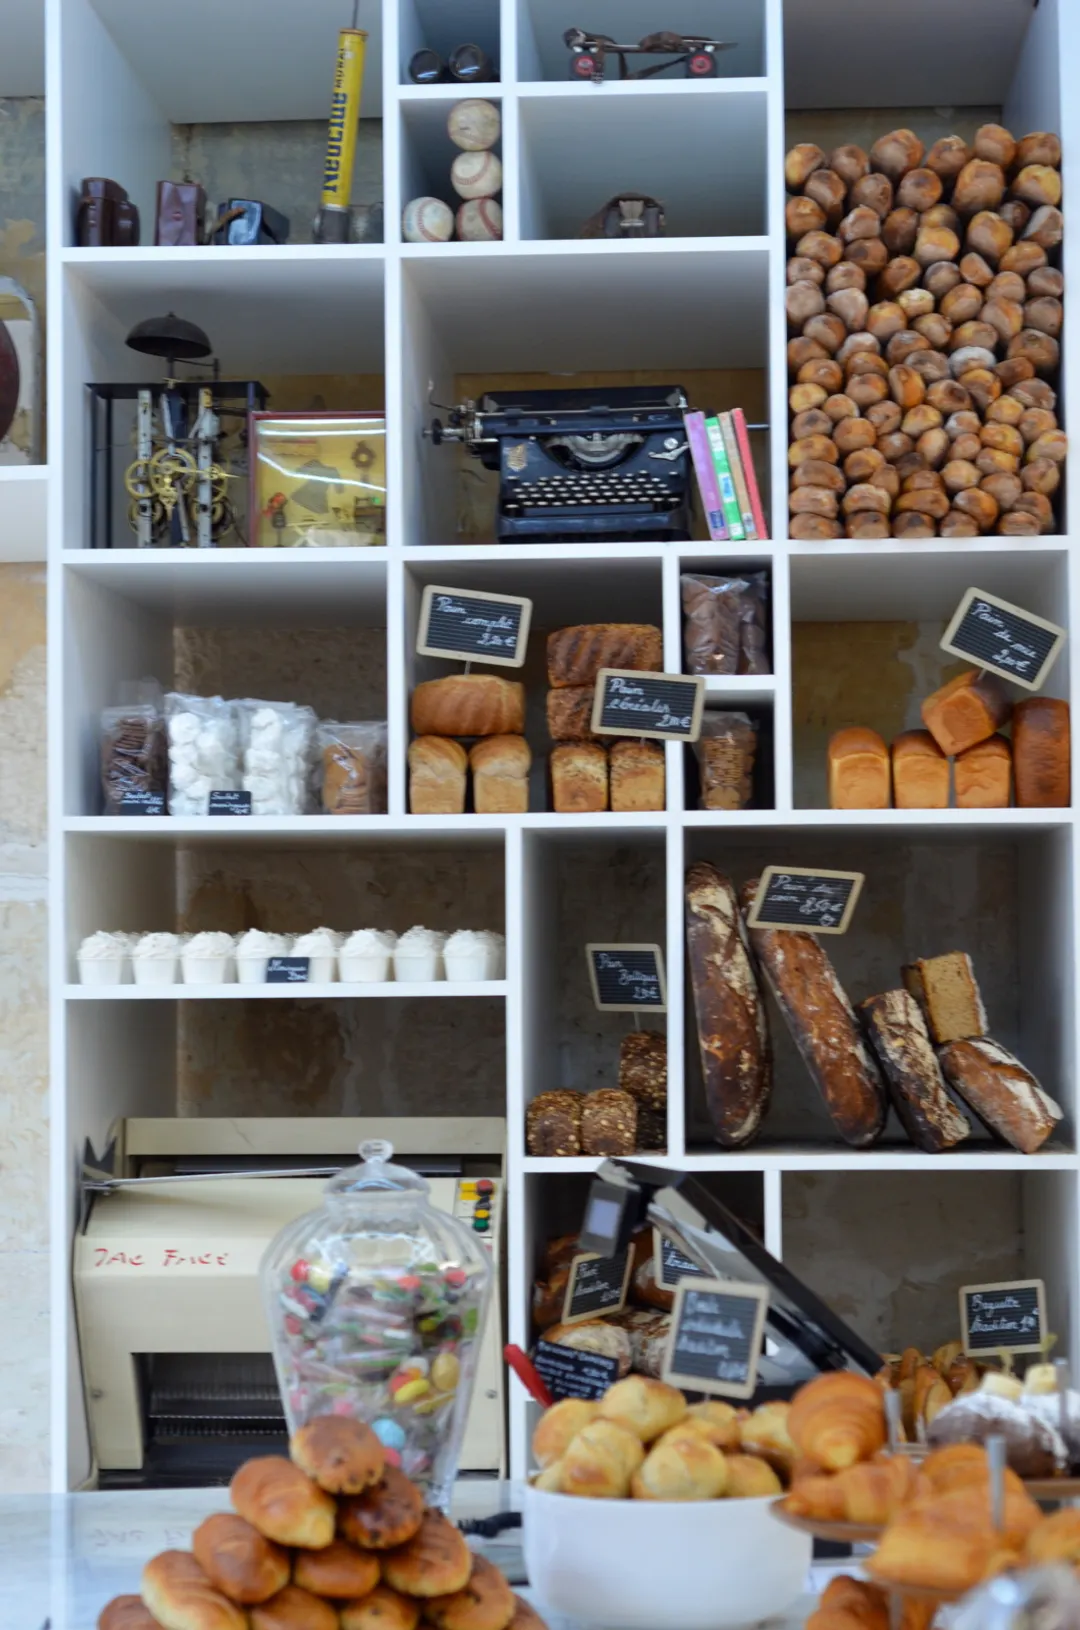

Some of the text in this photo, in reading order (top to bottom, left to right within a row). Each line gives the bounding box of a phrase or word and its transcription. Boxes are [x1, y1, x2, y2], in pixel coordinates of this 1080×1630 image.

[436, 596, 467, 614] Pain
[970, 602, 1005, 628] Pain
[993, 629, 1013, 642] de
[609, 678, 645, 695] Pain
[772, 875, 808, 892] Pain
